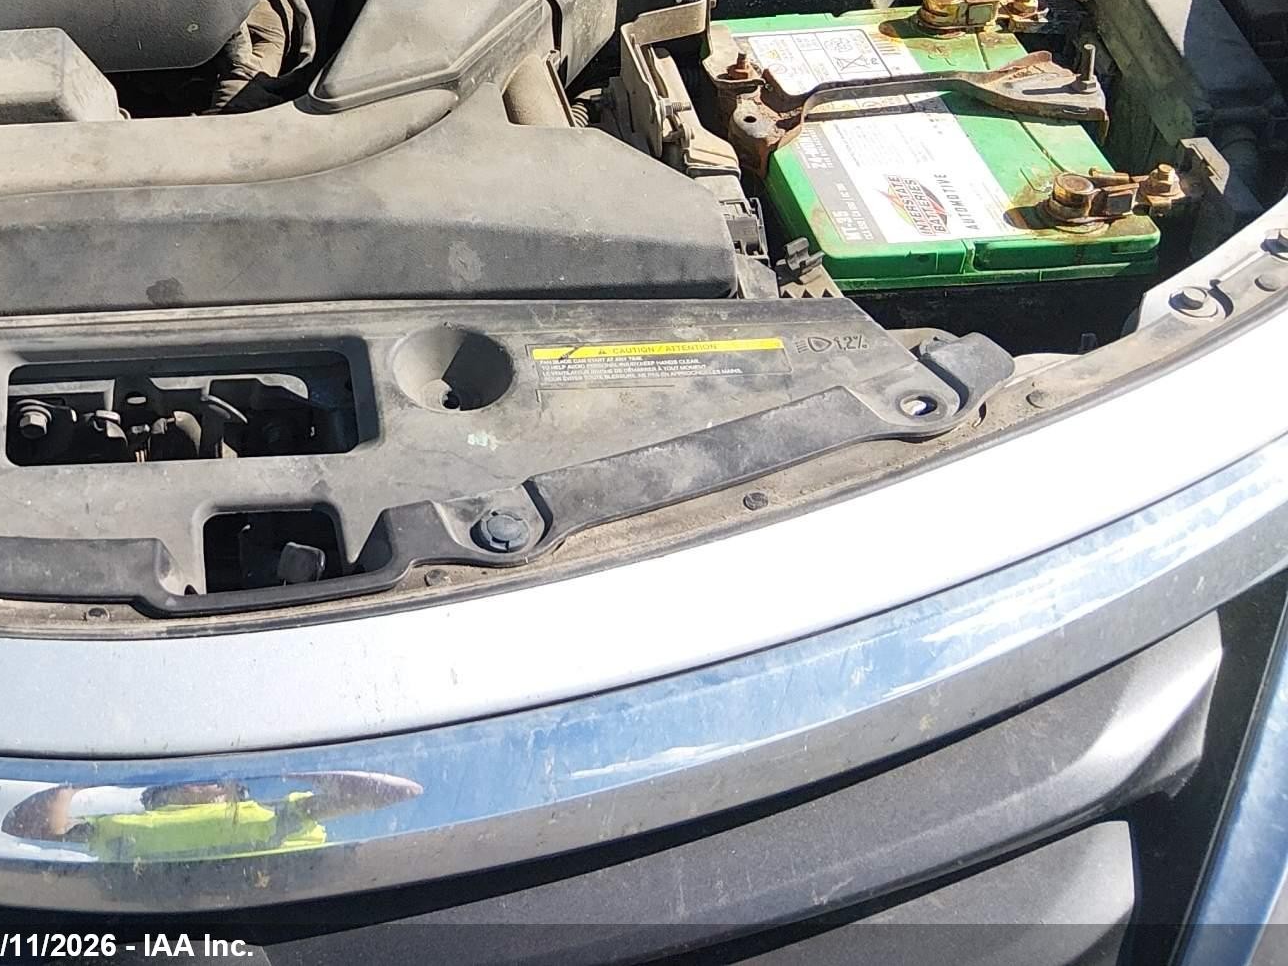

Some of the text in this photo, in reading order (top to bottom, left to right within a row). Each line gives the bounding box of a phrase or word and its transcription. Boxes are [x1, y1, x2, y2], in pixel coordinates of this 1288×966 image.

[887, 176, 930, 236] INTERSTATE
[903, 178, 946, 233] BATTERIES
[933, 172, 980, 231] AUTOMOTIVE
[665, 343, 717, 353] ATTENTION
